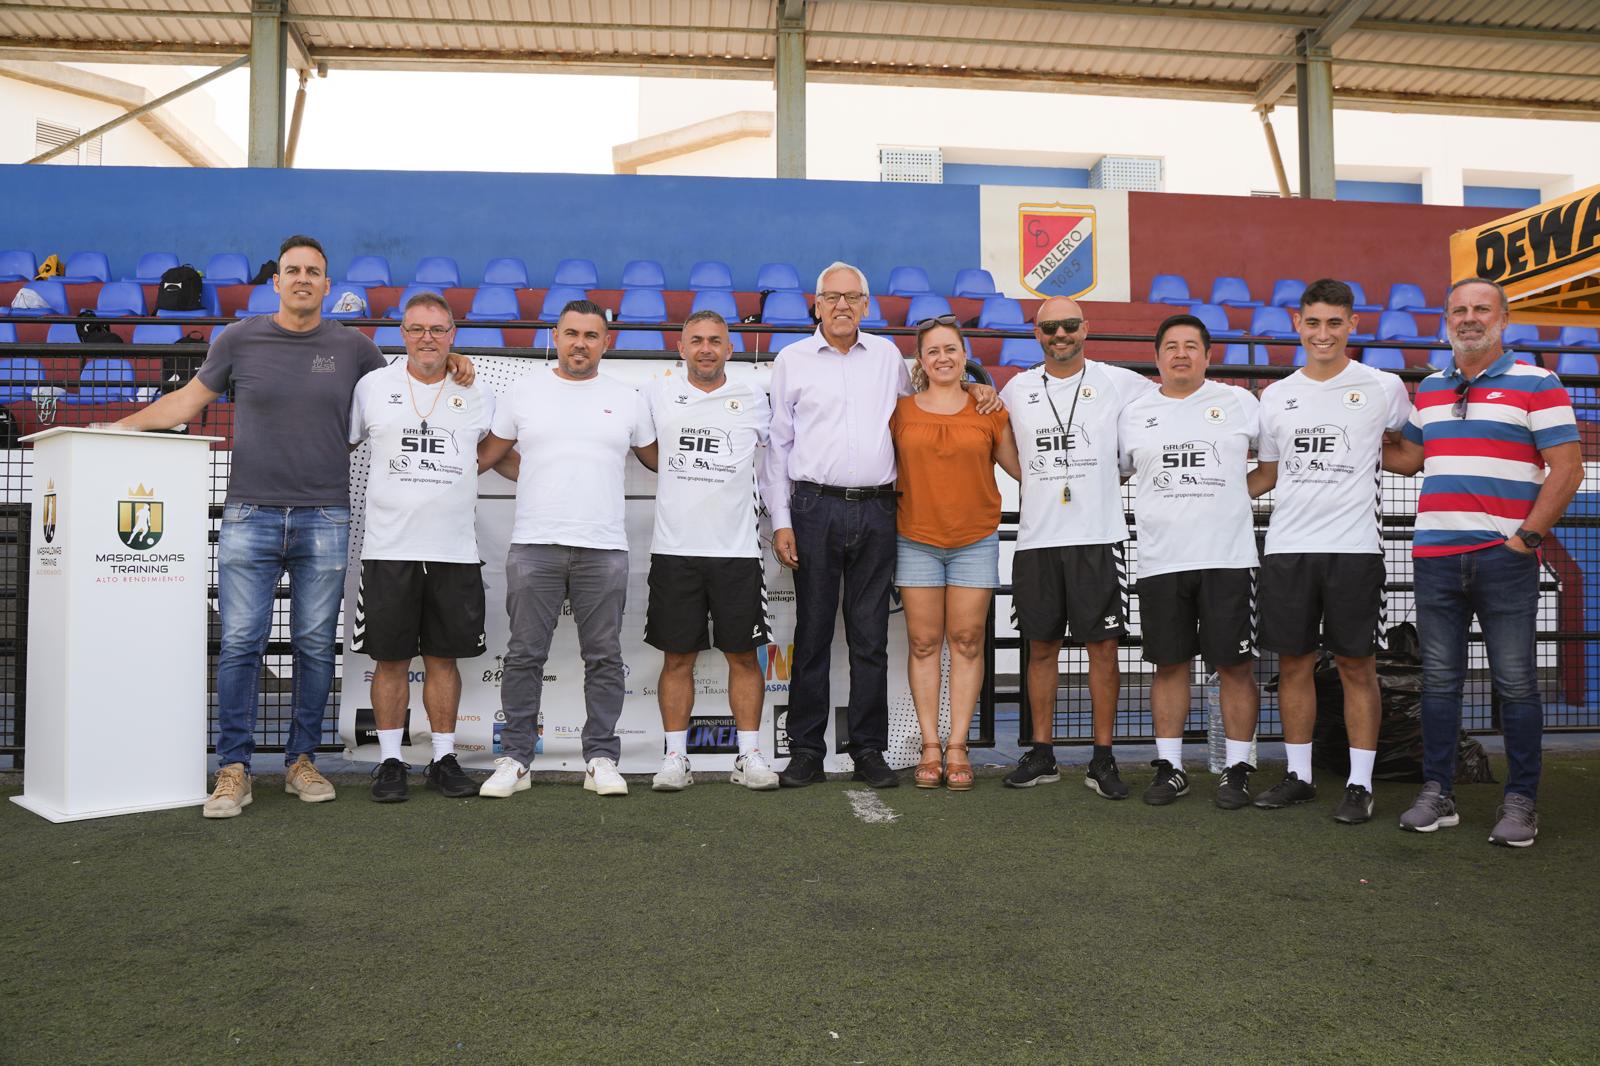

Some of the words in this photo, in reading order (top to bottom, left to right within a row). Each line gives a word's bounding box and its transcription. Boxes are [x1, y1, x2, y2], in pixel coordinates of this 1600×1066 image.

[1031, 230, 1082, 280] TABLERO
[401, 437, 445, 454] SIE
[679, 436, 720, 454] SIE
[1036, 434, 1076, 452] SIE
[1294, 436, 1336, 453] SIE
[1162, 452, 1206, 468] SIE
[95, 553, 185, 562] MASPALOMAS
[110, 565, 169, 573] TRAINING
[704, 686, 729, 694] TIRAJAN
